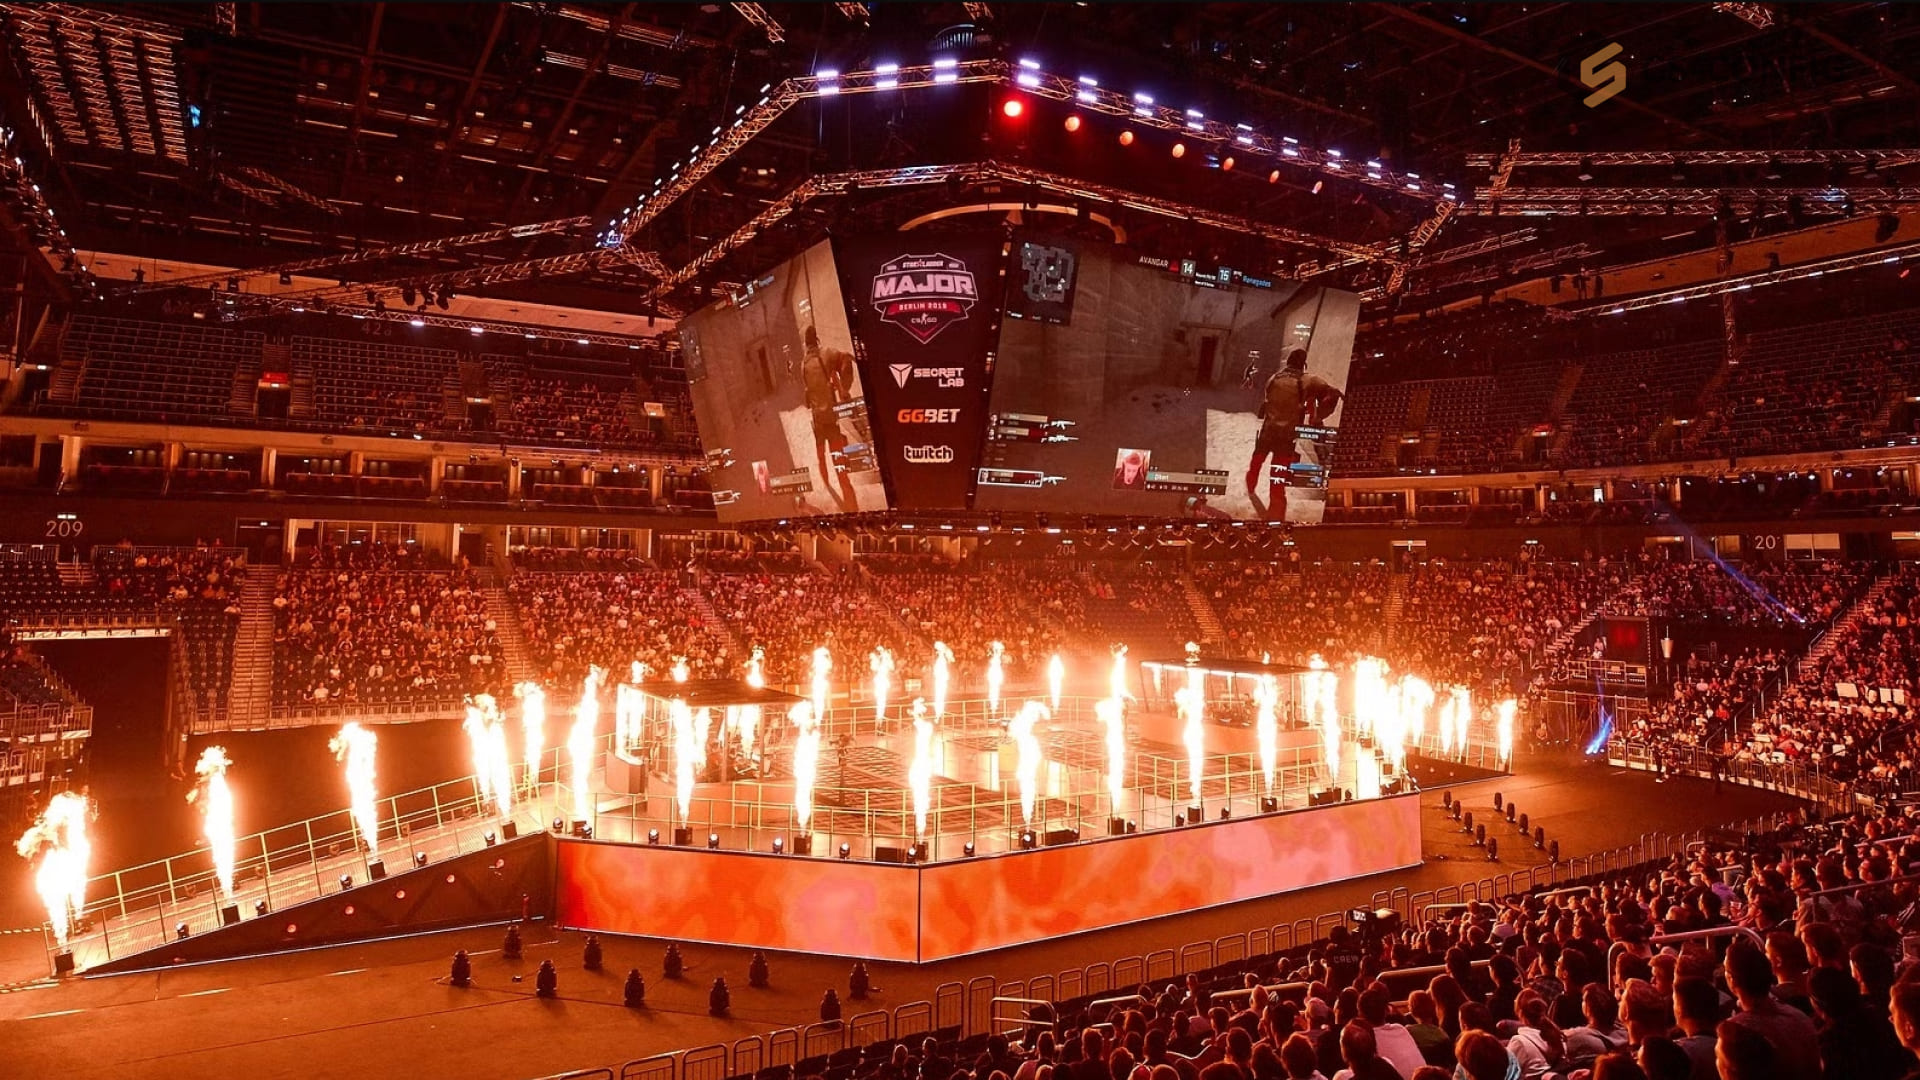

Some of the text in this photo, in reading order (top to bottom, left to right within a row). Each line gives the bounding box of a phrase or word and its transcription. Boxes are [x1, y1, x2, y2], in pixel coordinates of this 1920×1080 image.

[1183, 262, 1194, 275] 14
[1220, 269, 1230, 281] 15
[874, 273, 975, 299] MAJOR
[898, 302, 926, 311] BERLIN
[913, 367, 965, 379] SECRET
[938, 378, 965, 388] LAB
[904, 446, 953, 462] twitch
[45, 520, 84, 538] 209
[1754, 534, 1780, 551] 20
